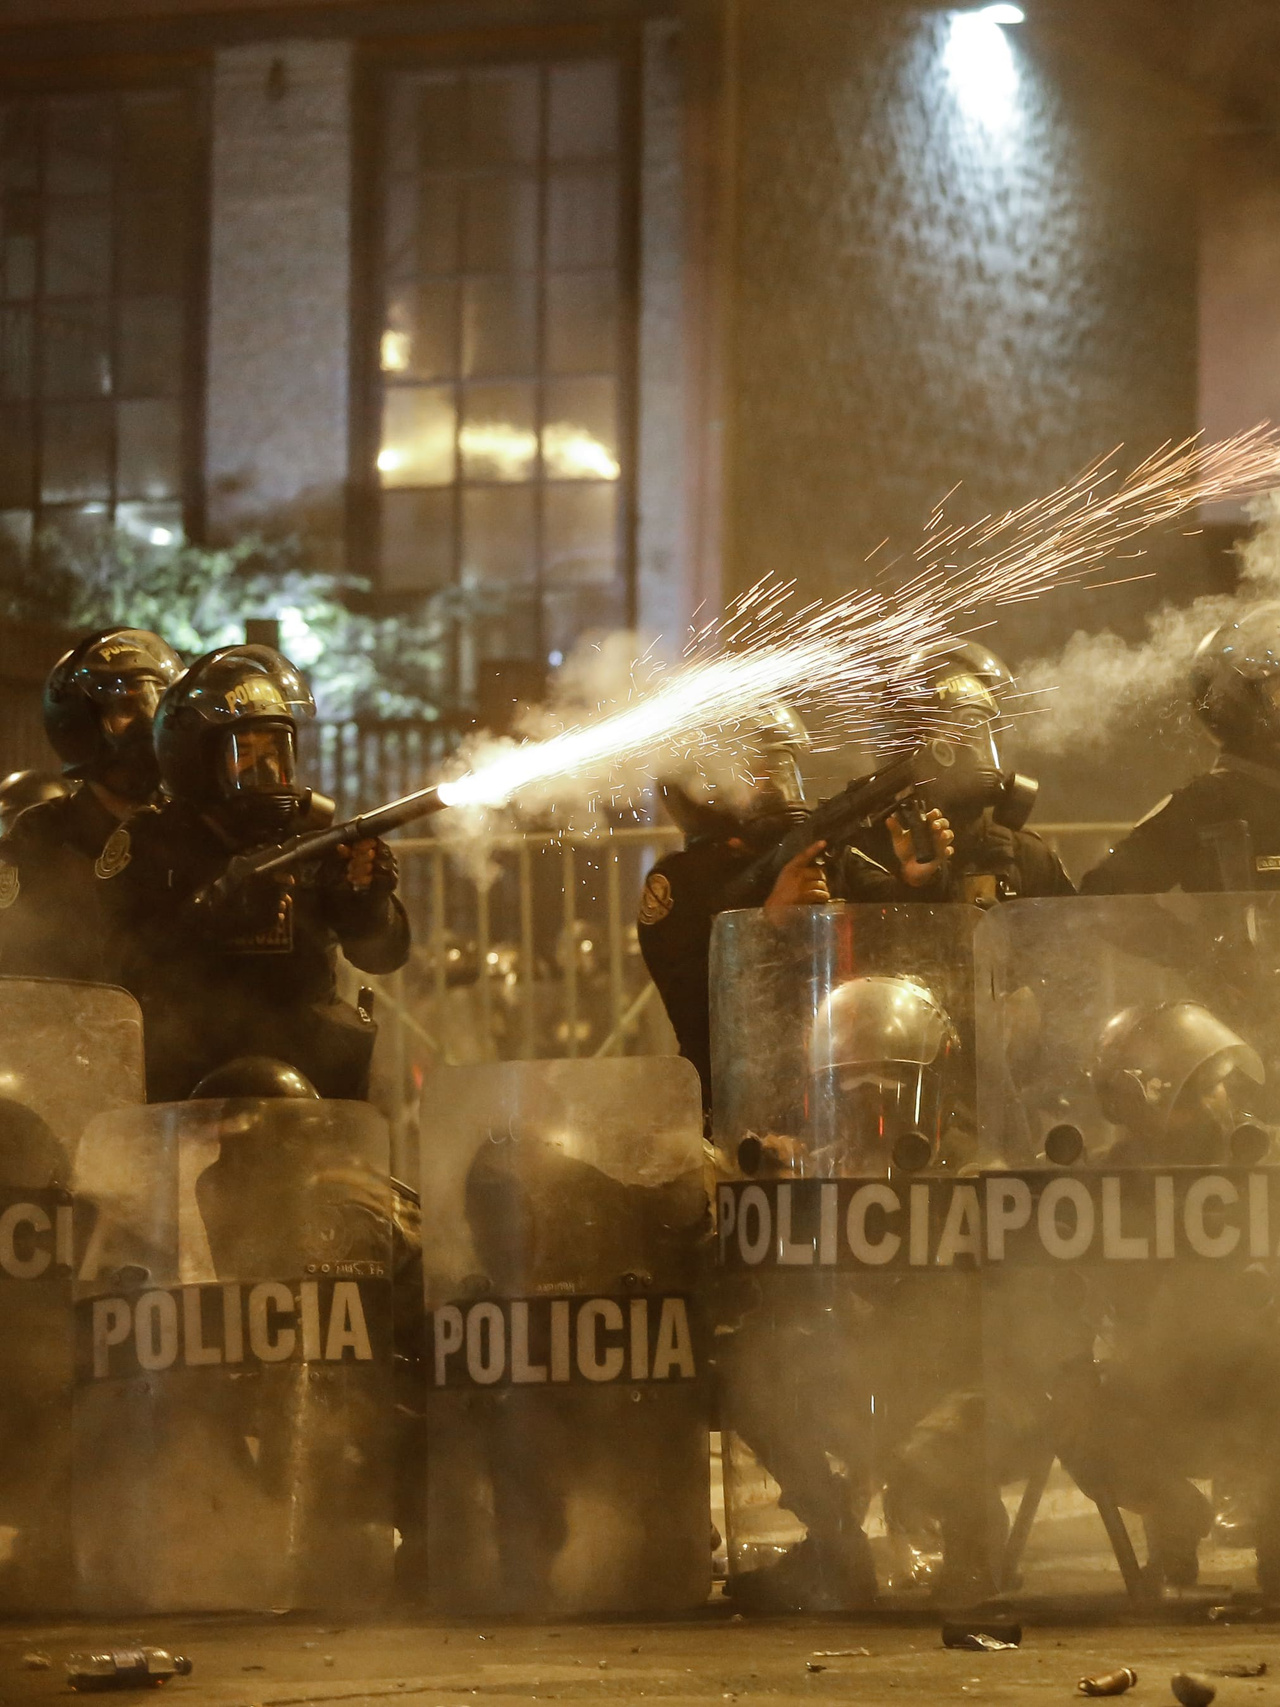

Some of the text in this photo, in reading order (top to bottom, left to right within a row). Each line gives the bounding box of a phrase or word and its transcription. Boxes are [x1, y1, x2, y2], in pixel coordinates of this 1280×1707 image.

[719, 1183, 982, 1267] POLICIA
[93, 1281, 373, 1378] POLICIA
[434, 1299, 696, 1386] POLICIA
